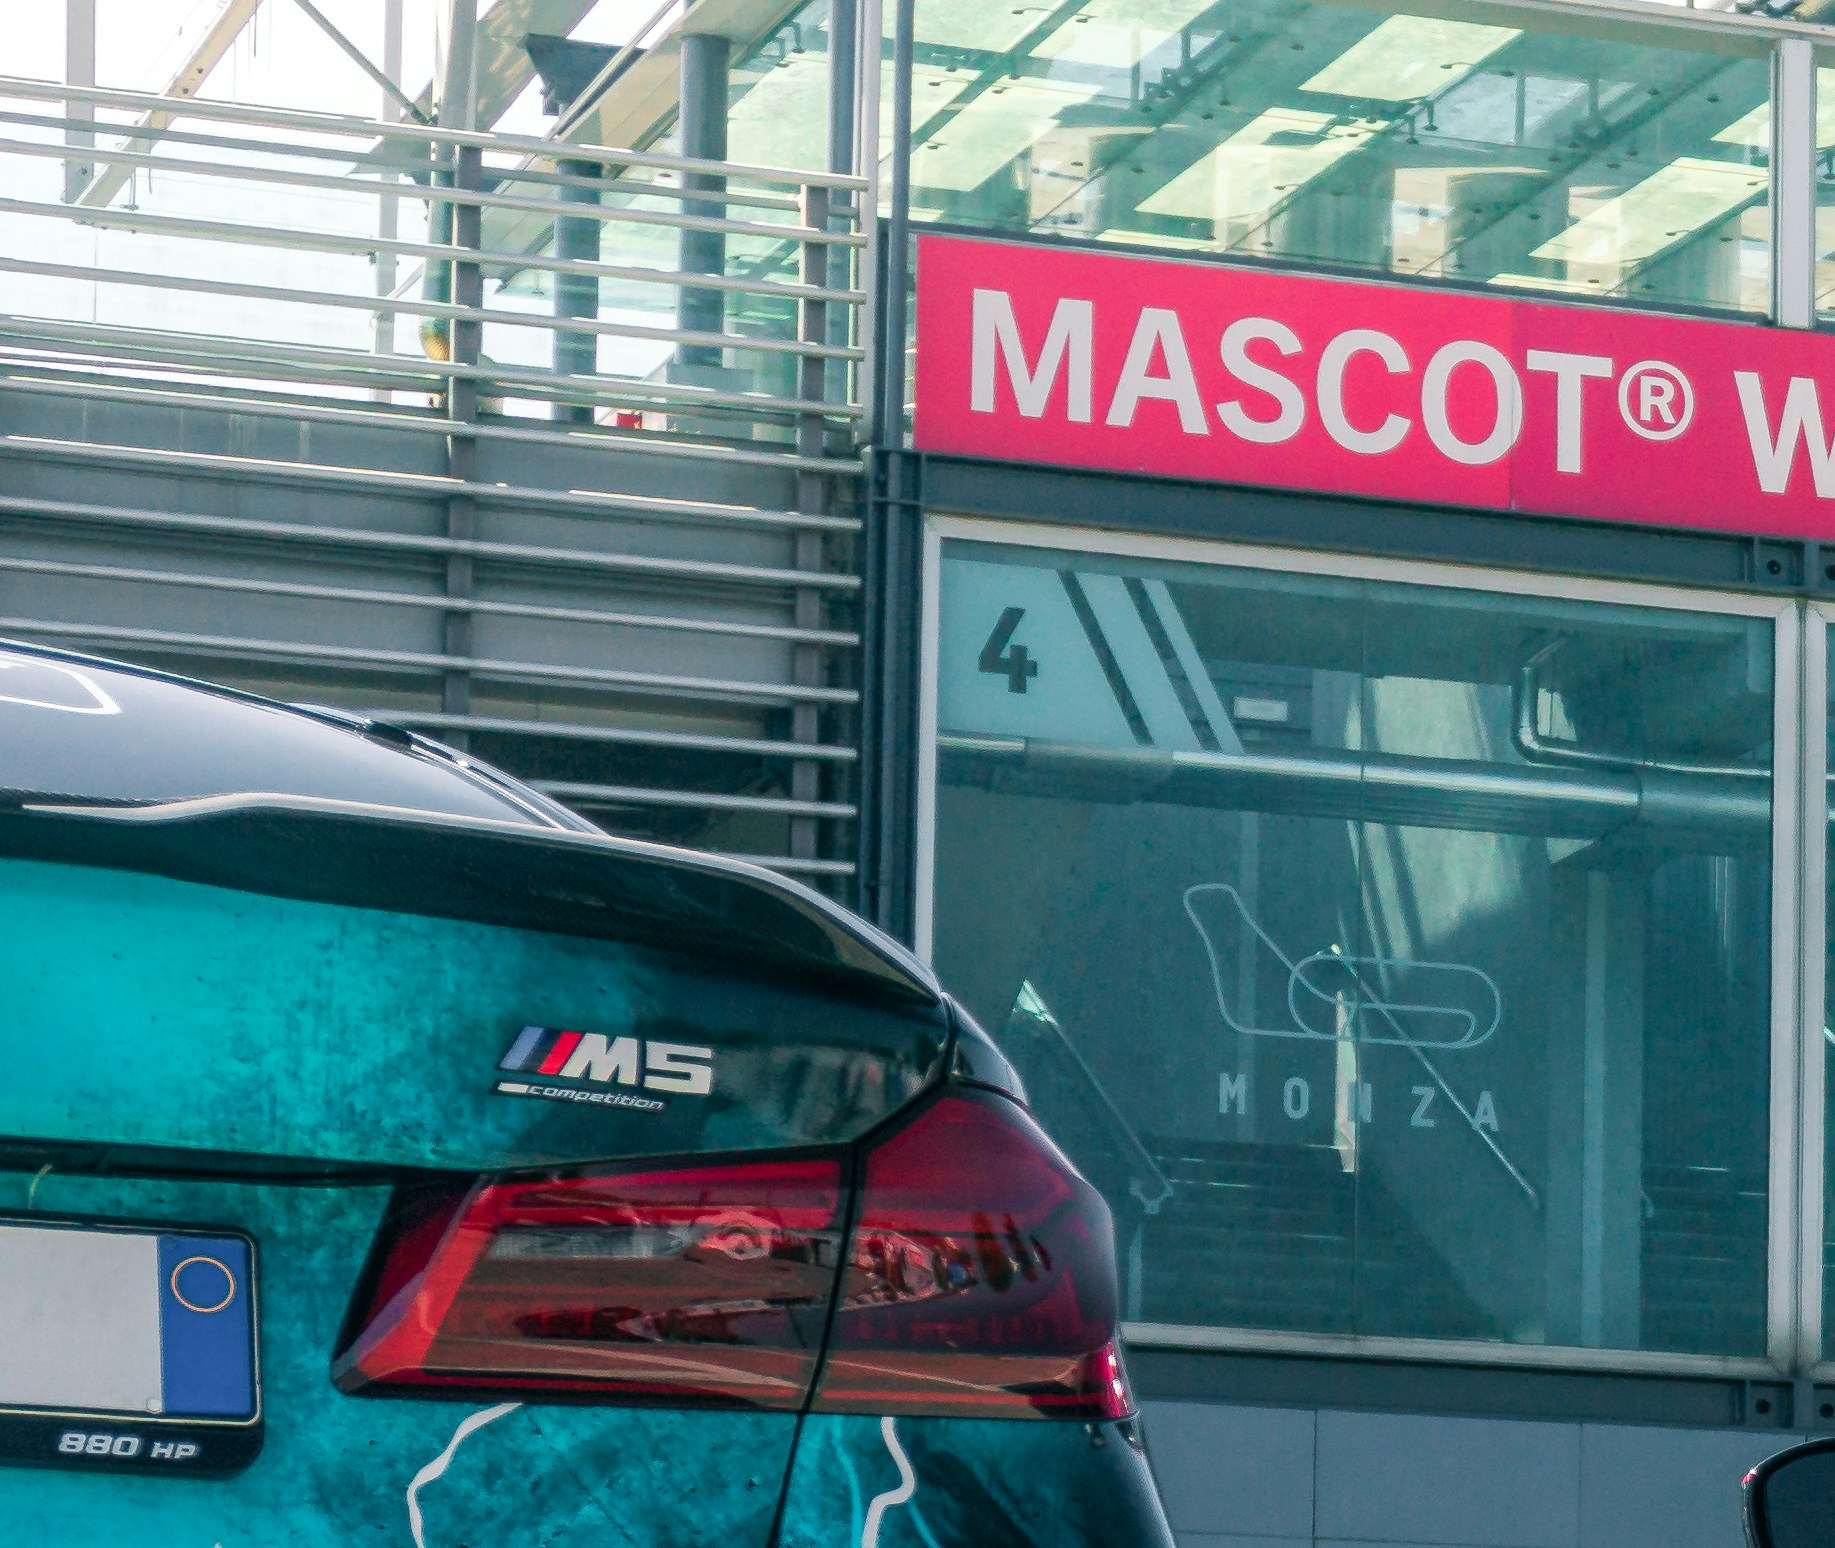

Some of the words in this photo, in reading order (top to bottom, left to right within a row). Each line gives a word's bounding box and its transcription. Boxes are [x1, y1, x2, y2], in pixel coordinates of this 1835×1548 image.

[970, 288, 1696, 476] MASCOT®
[977, 605, 1039, 695] 4
[559, 1032, 713, 1095] M5
[526, 1084, 665, 1111] competition
[1219, 1071, 1500, 1133] MONZA
[58, 1432, 141, 1458] 880
[150, 1440, 197, 1461] HP
